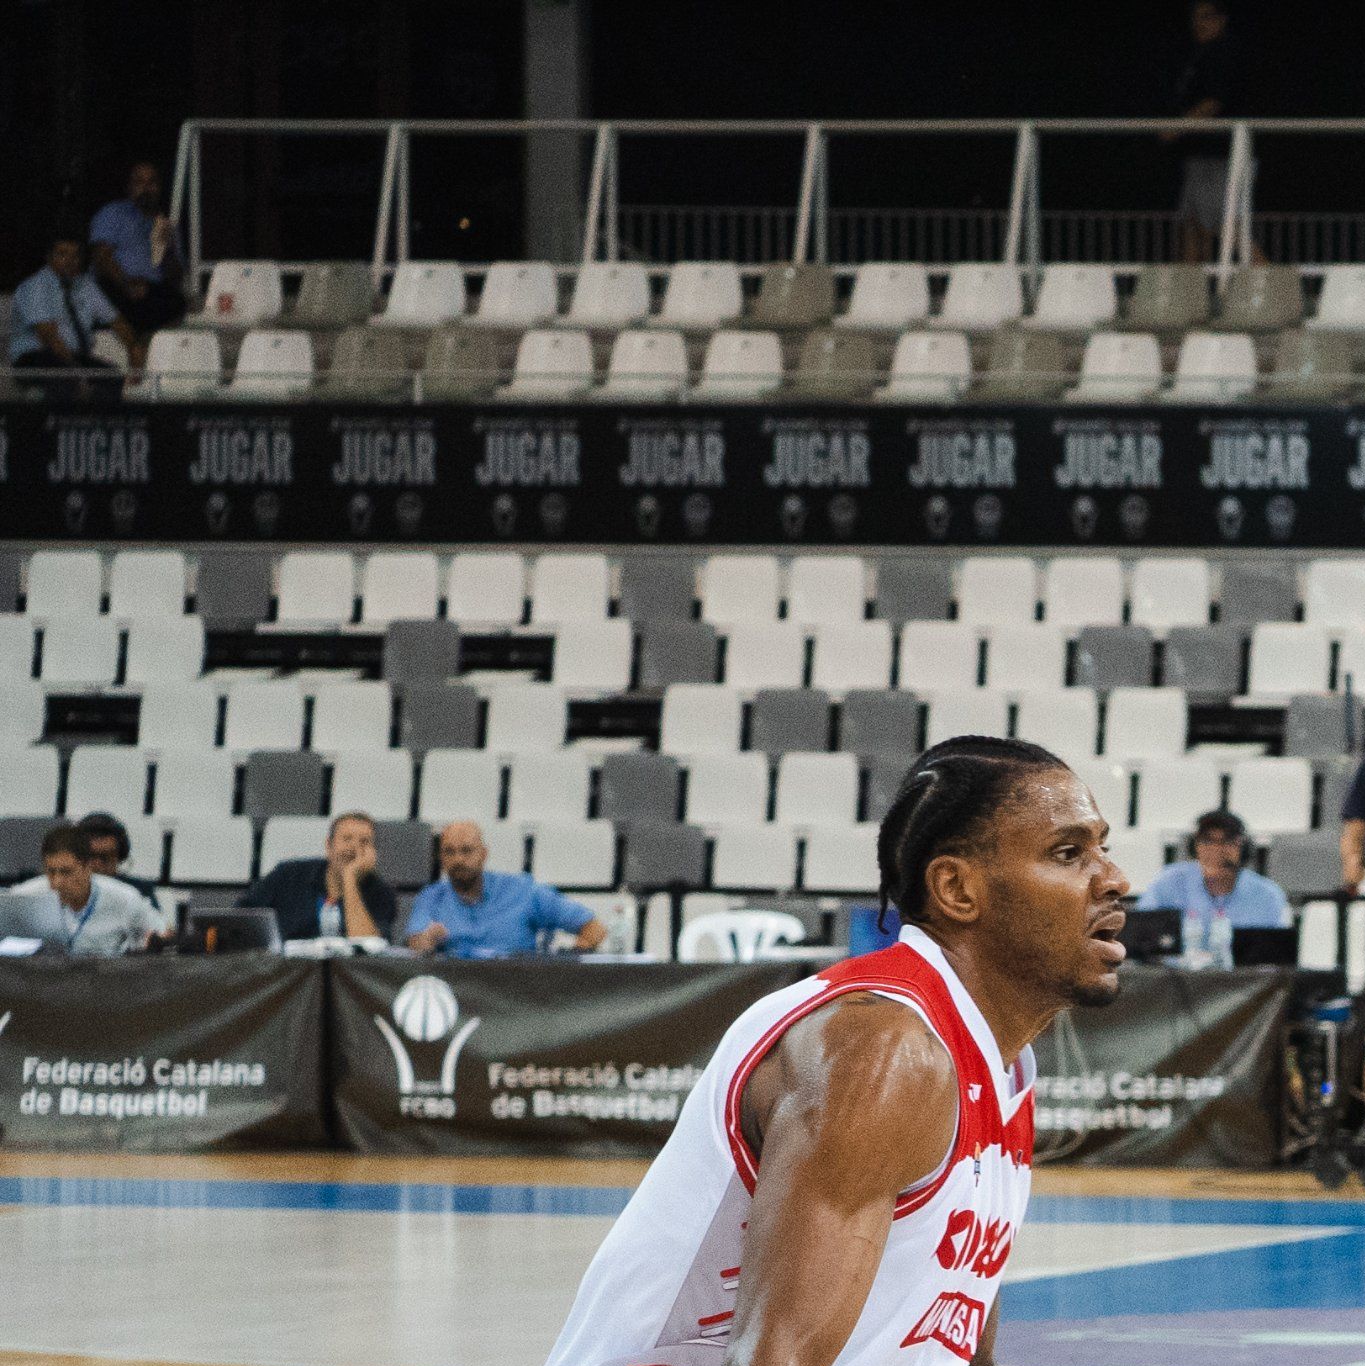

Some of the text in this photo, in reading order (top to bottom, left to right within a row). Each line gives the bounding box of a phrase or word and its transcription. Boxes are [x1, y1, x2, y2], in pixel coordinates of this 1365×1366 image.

[48, 430, 149, 482] JUGAR
[190, 430, 293, 483] JUGAR
[332, 431, 436, 484] JUGAR
[475, 432, 580, 485] JUGAR
[619, 432, 725, 486] JUGAR
[763, 432, 870, 486] JUGAR
[909, 433, 1016, 488] JUGAR
[1054, 434, 1162, 488] JUGAR
[1201, 434, 1308, 488] JUGAR
[23, 1056, 266, 1087] Federació Catalana
[20, 1087, 208, 1120] de Basquetbol
[490, 1092, 527, 1119] de
